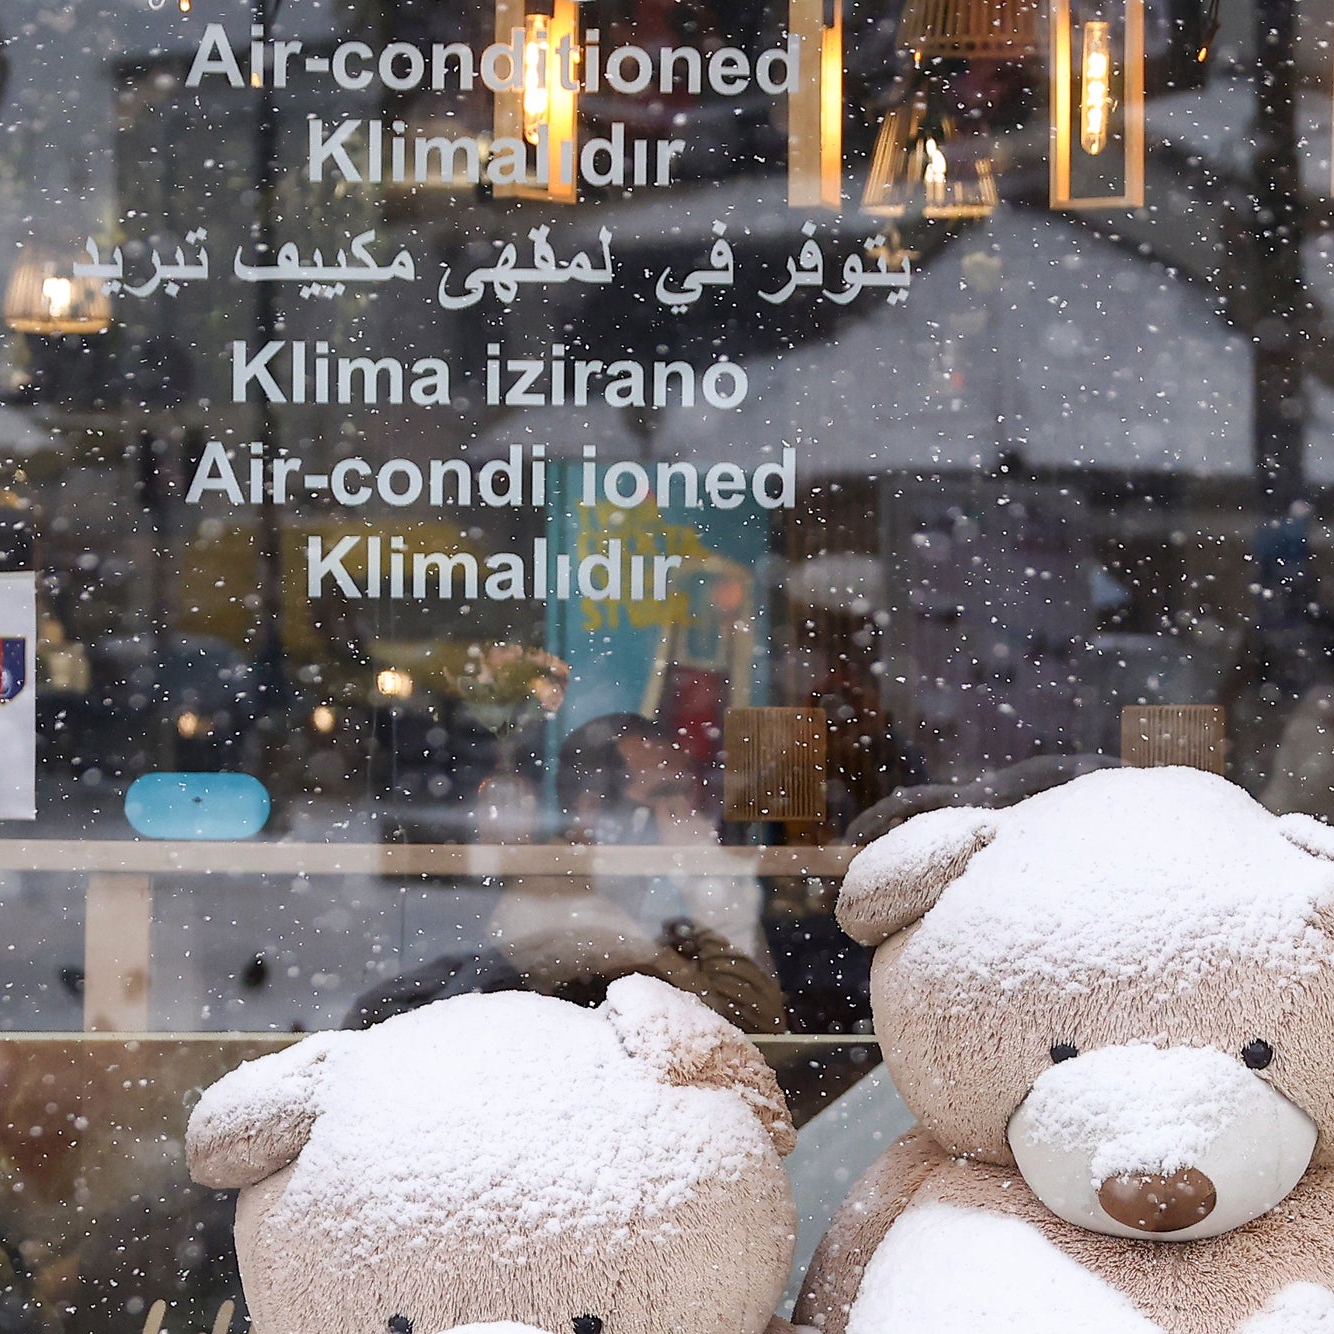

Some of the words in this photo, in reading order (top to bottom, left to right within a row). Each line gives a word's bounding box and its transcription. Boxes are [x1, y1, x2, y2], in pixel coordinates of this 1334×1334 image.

[185, 22, 802, 97] Air-conditioned
[655, 220, 735, 315] في
[758, 221, 912, 305] يتوفر
[232, 340, 451, 406] Klima
[486, 343, 750, 409] izirano
